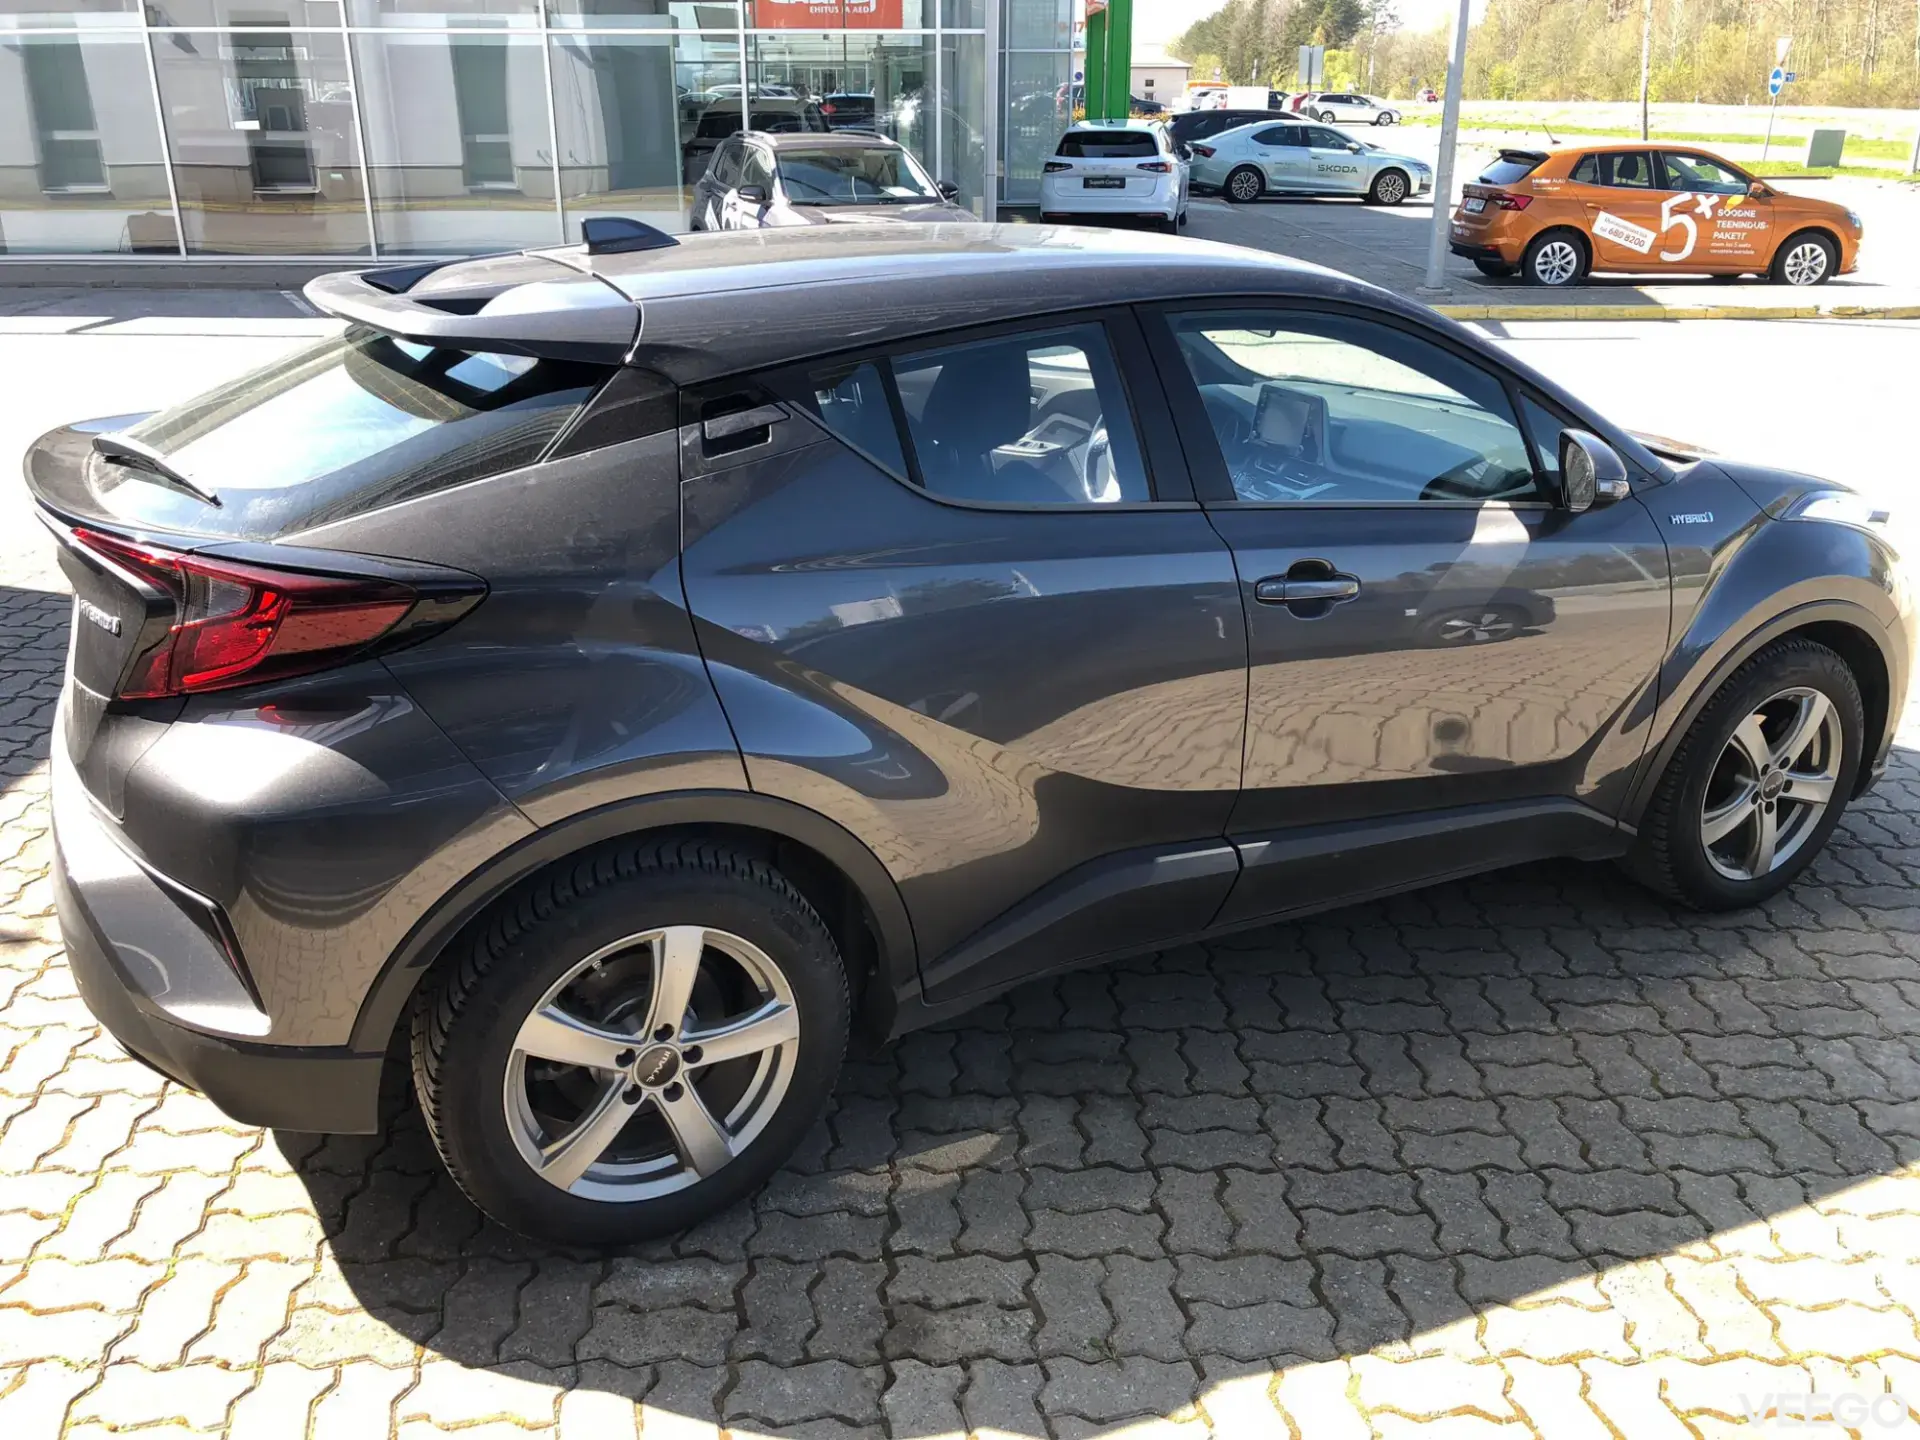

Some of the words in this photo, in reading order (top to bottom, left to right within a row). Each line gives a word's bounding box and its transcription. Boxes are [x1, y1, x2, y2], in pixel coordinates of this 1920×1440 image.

[810, 6, 839, 14] EHITUS
[1717, 209, 1757, 218] SOODNE
[1608, 227, 1625, 239] 680
[1624, 232, 1646, 248] 8200
[1712, 231, 1748, 241] PAKETT
[1670, 512, 1709, 525] HYBRID
